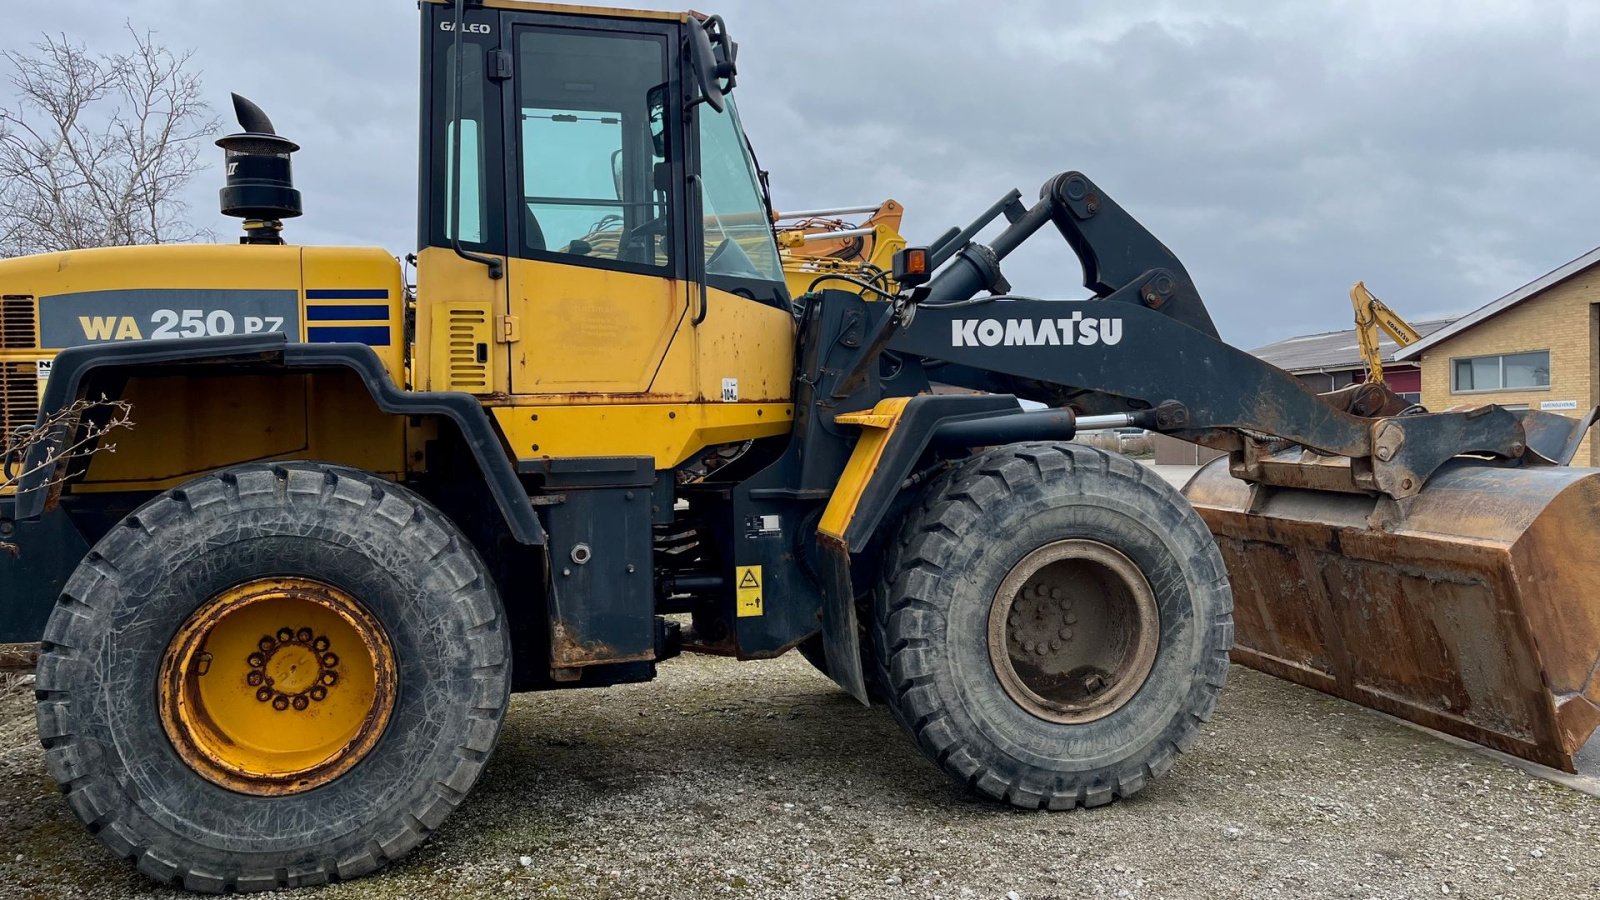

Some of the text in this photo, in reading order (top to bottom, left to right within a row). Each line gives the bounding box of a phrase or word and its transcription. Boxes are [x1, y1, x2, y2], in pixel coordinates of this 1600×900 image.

[79, 316, 143, 341] WA
[151, 309, 235, 340] 250
[952, 311, 1122, 347] KOMATSU
[1386, 320, 1410, 343] KOMATSU
